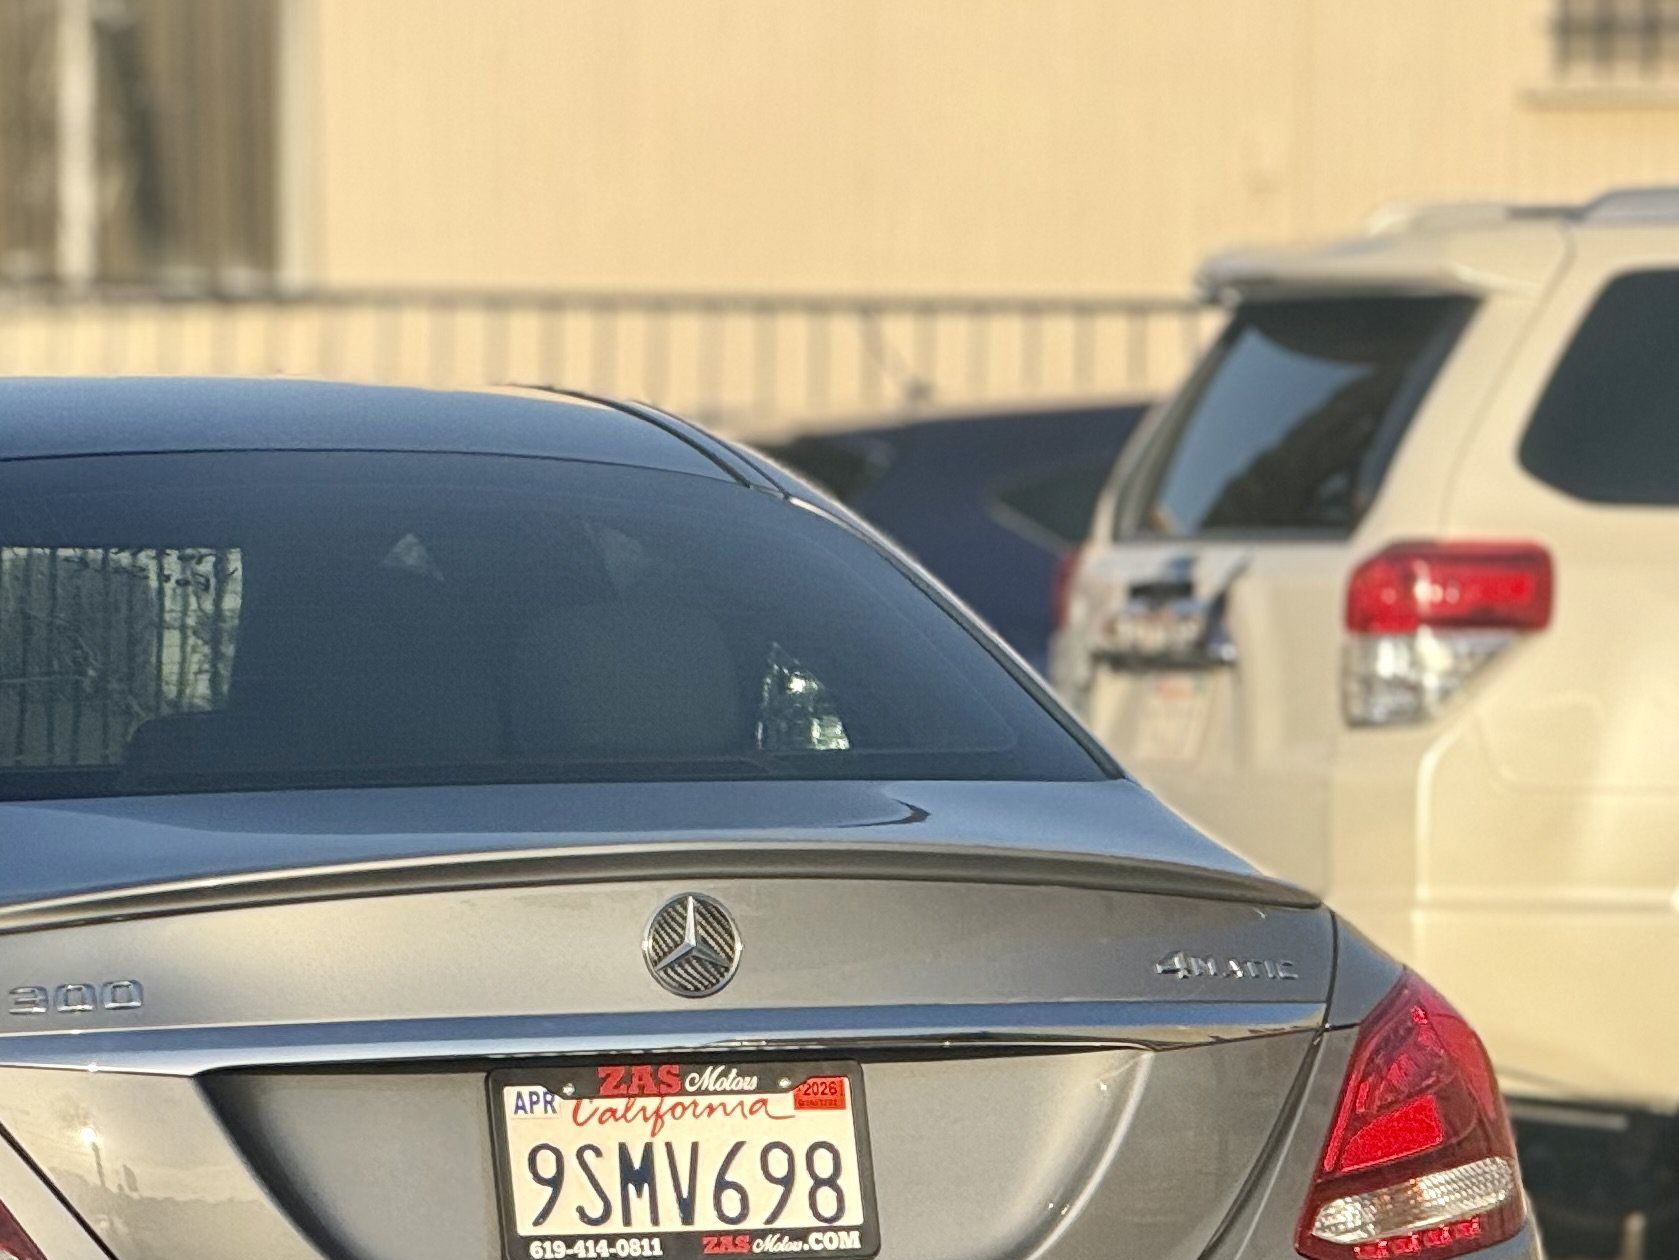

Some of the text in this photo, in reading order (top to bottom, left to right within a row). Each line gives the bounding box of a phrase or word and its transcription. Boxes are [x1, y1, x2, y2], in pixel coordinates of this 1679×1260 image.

[1155, 950, 1299, 980] 4MATIC
[8, 979, 144, 1015] 300
[597, 1064, 758, 1096] ZAS Motors
[803, 1080, 838, 1097] 2026
[513, 1090, 558, 1115] APR
[572, 1096, 795, 1138] California
[527, 1140, 846, 1228] 9SMV698
[529, 1237, 664, 1260] 619-414-0811
